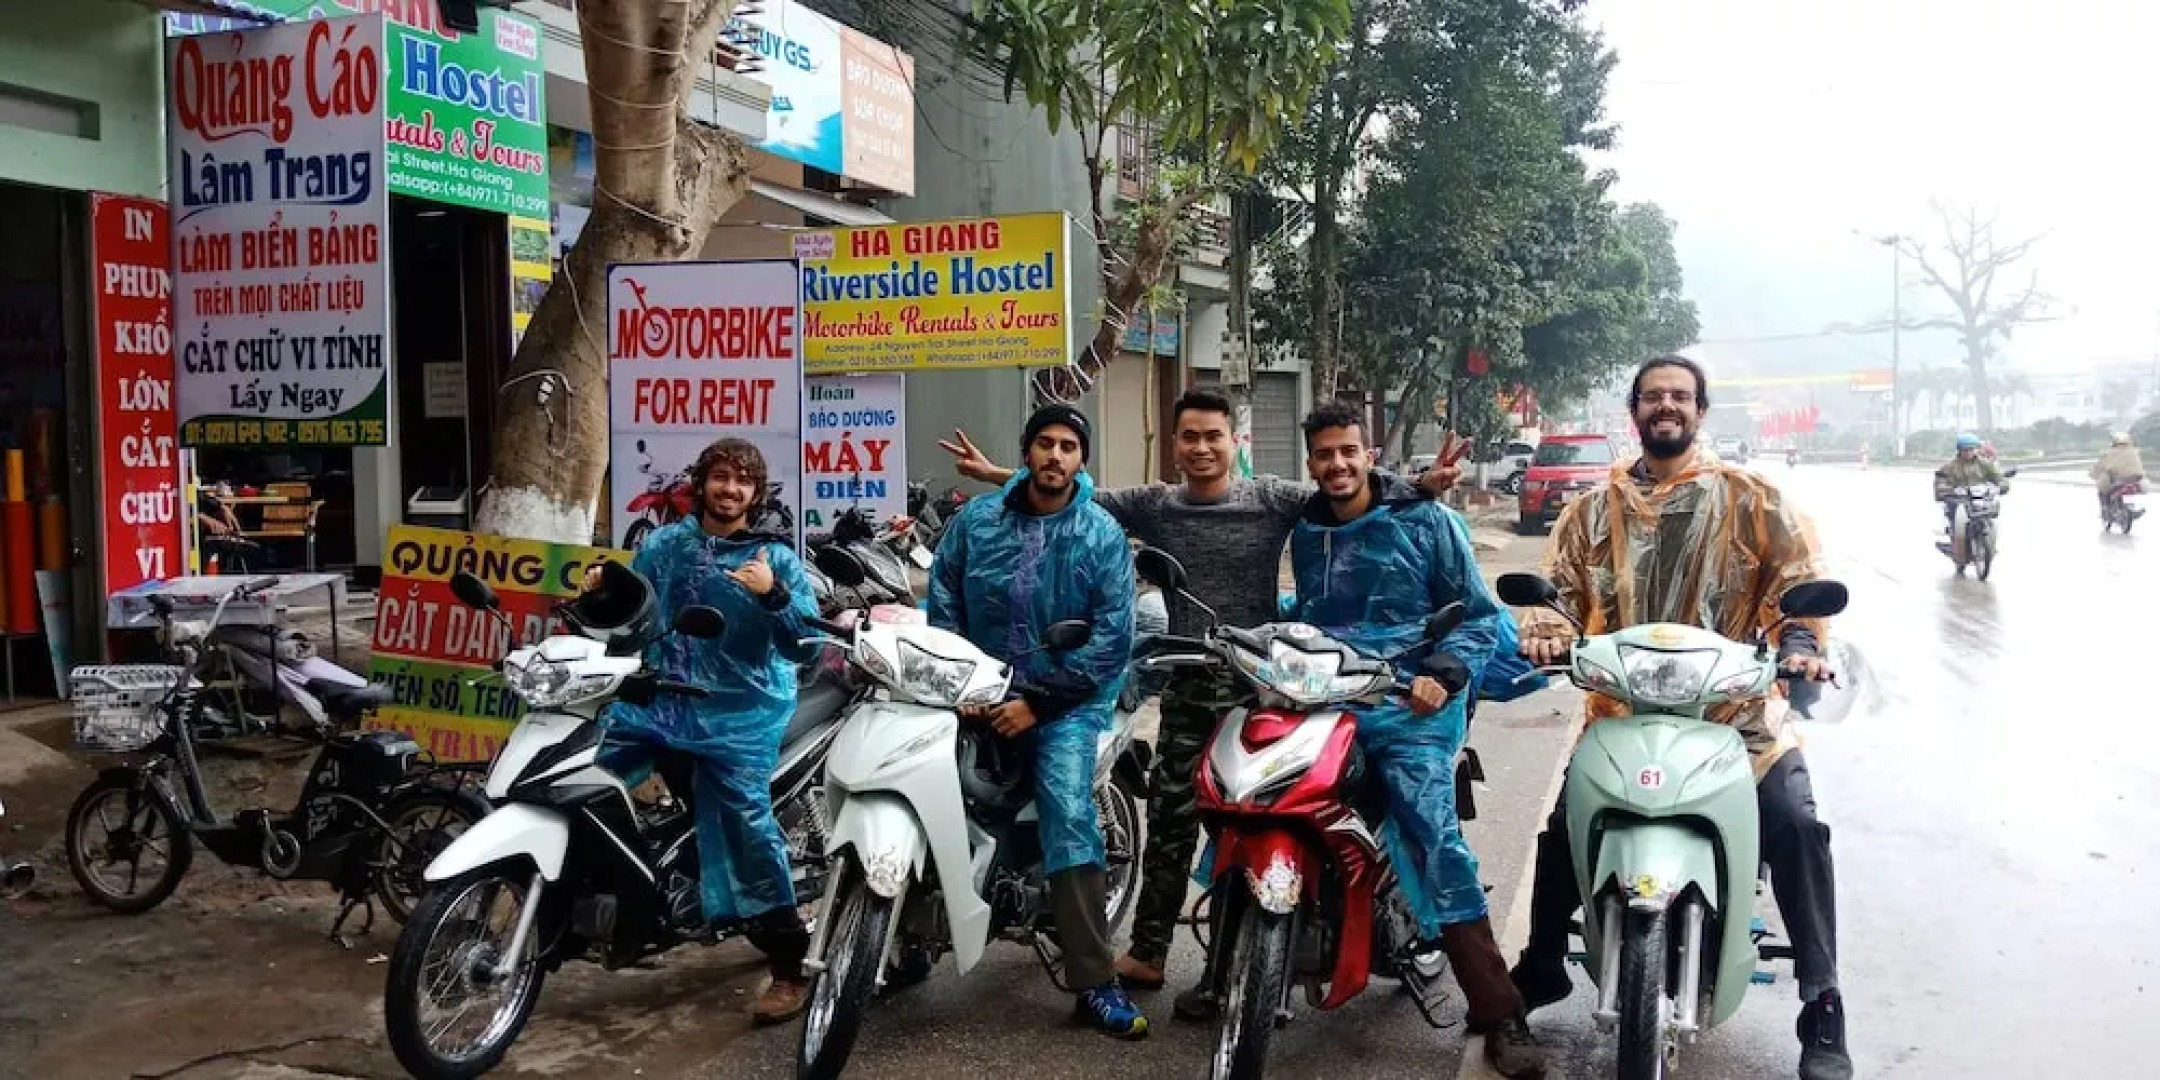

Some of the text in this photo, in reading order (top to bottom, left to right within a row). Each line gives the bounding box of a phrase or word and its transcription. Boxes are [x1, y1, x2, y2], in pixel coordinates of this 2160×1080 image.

[176, 21, 377, 143] Quảng Cáo
[402, 35, 539, 124] Hostel
[473, 118, 543, 175] Tours
[181, 148, 371, 206] Lâm Trang
[124, 207, 152, 242] IN
[180, 210, 378, 272] LÀM BIỂN BẢNG
[852, 221, 1000, 258] HA GIANG
[194, 272, 364, 318] TRÊN MỌI CHẤT LIỆU
[803, 251, 1054, 302] Riverside Hostel
[114, 307, 169, 354] KHỔ
[612, 306, 794, 359] MOTORBIKE
[803, 299, 1059, 338] Motorbike Rentals & Tours
[184, 321, 383, 374] CẮT CHỮ VI TÍNH
[118, 369, 170, 411] LỚN
[230, 378, 344, 413] Lấy Ngay
[120, 418, 173, 468] CẮT
[805, 431, 890, 473] MÁY
[120, 482, 177, 524] CHỮ
[137, 546, 164, 580] VI
[392, 535, 545, 586] QUẢNG
[377, 582, 438, 652] CẮT
[1640, 770, 1661, 787] 61
